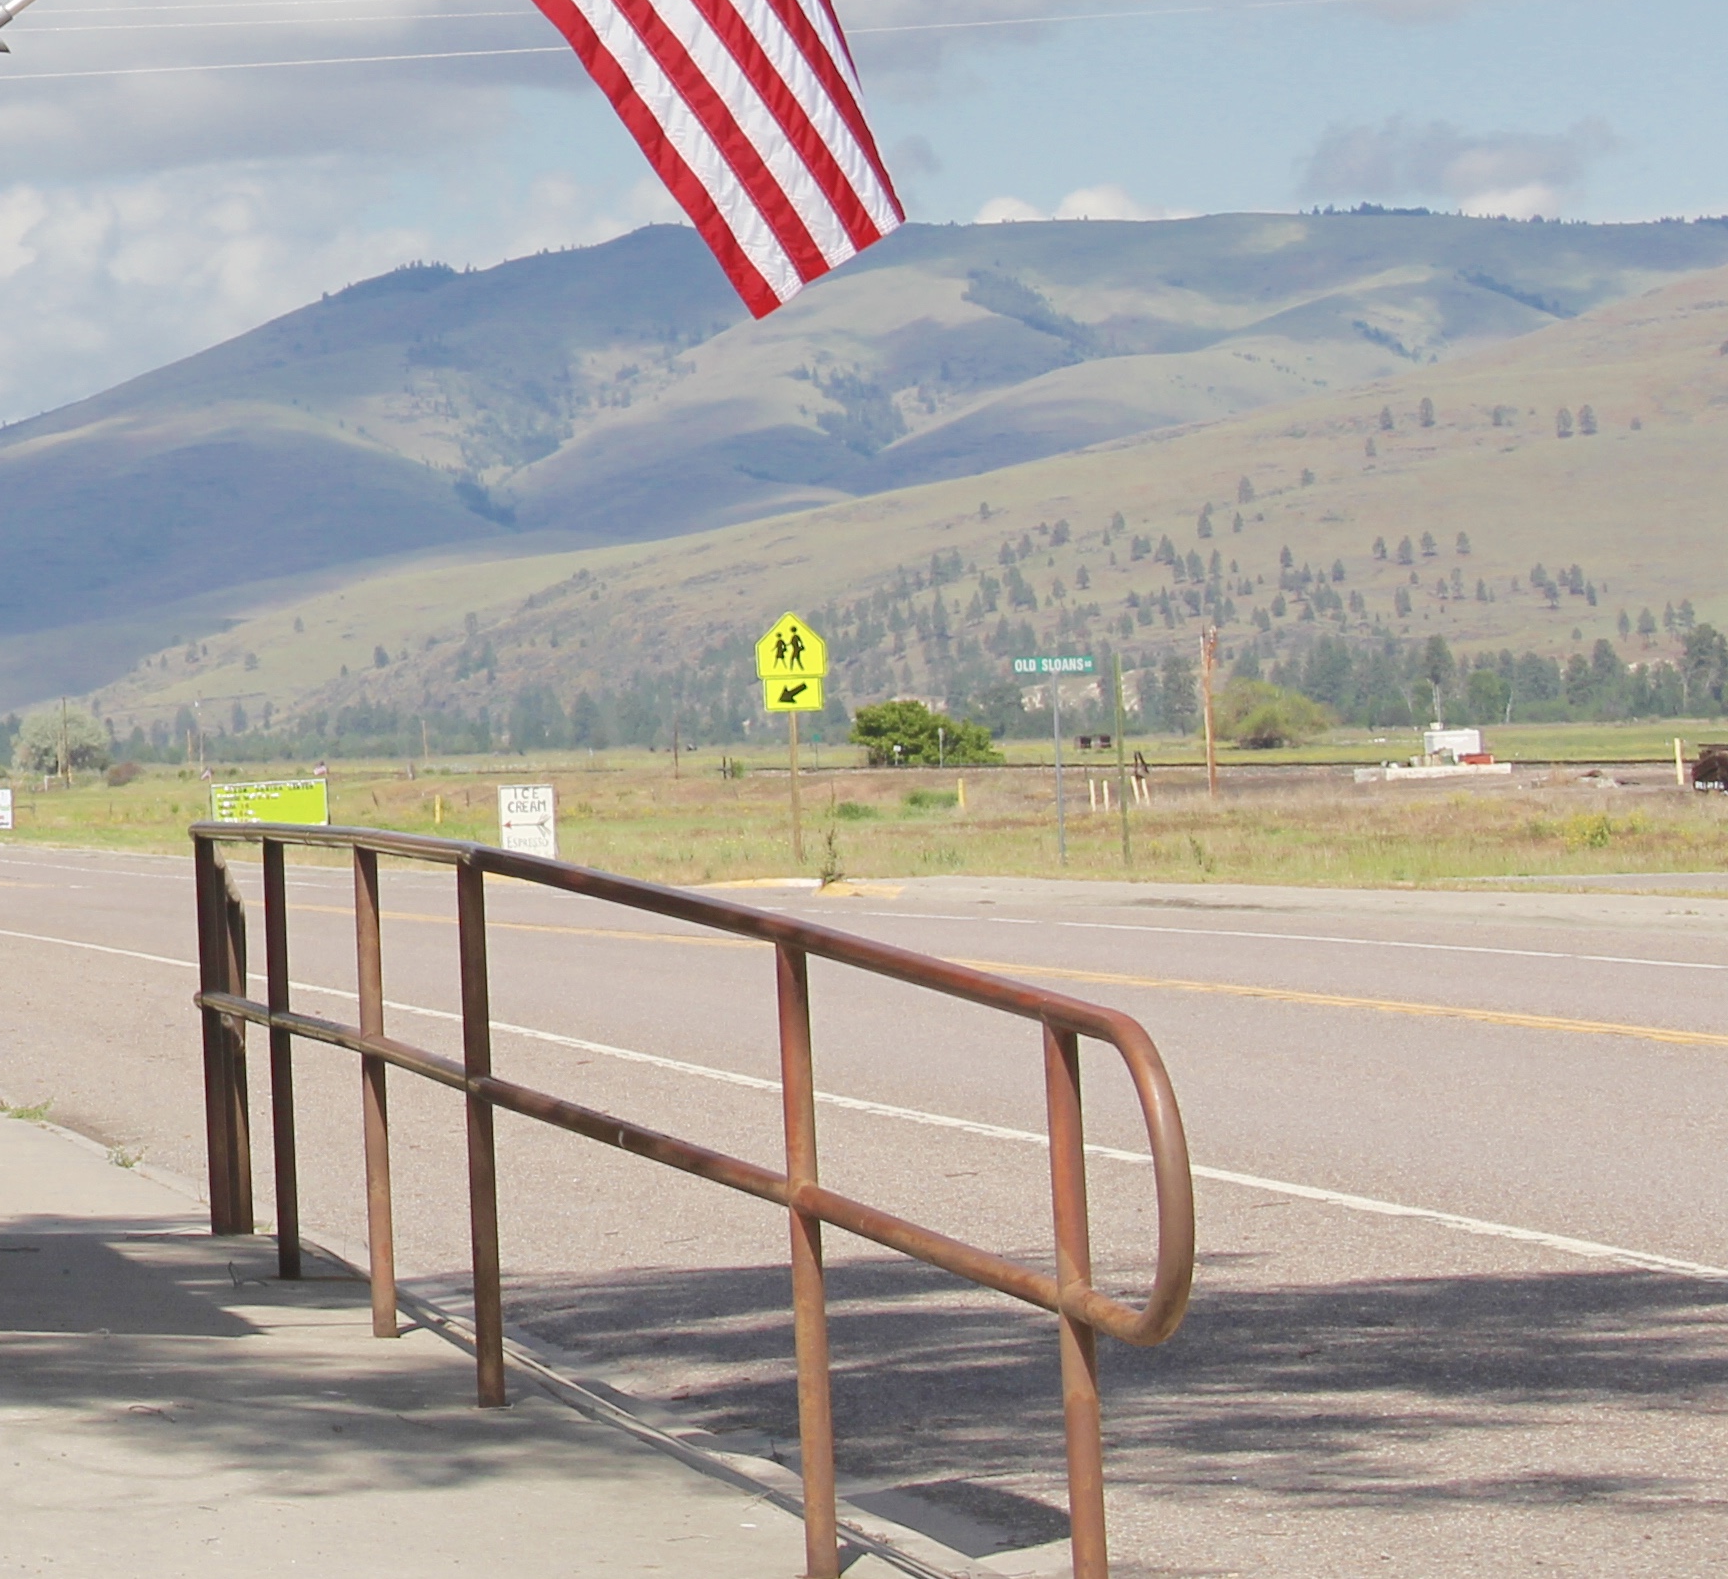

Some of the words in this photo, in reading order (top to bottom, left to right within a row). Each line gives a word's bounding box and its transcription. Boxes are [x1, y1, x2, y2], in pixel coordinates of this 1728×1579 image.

[1014, 658, 1037, 672] OLD
[1041, 657, 1084, 672] SLOANS
[512, 787, 540, 800] ICE
[507, 800, 547, 813] CREAM
[506, 836, 550, 849] ESPRESSO
